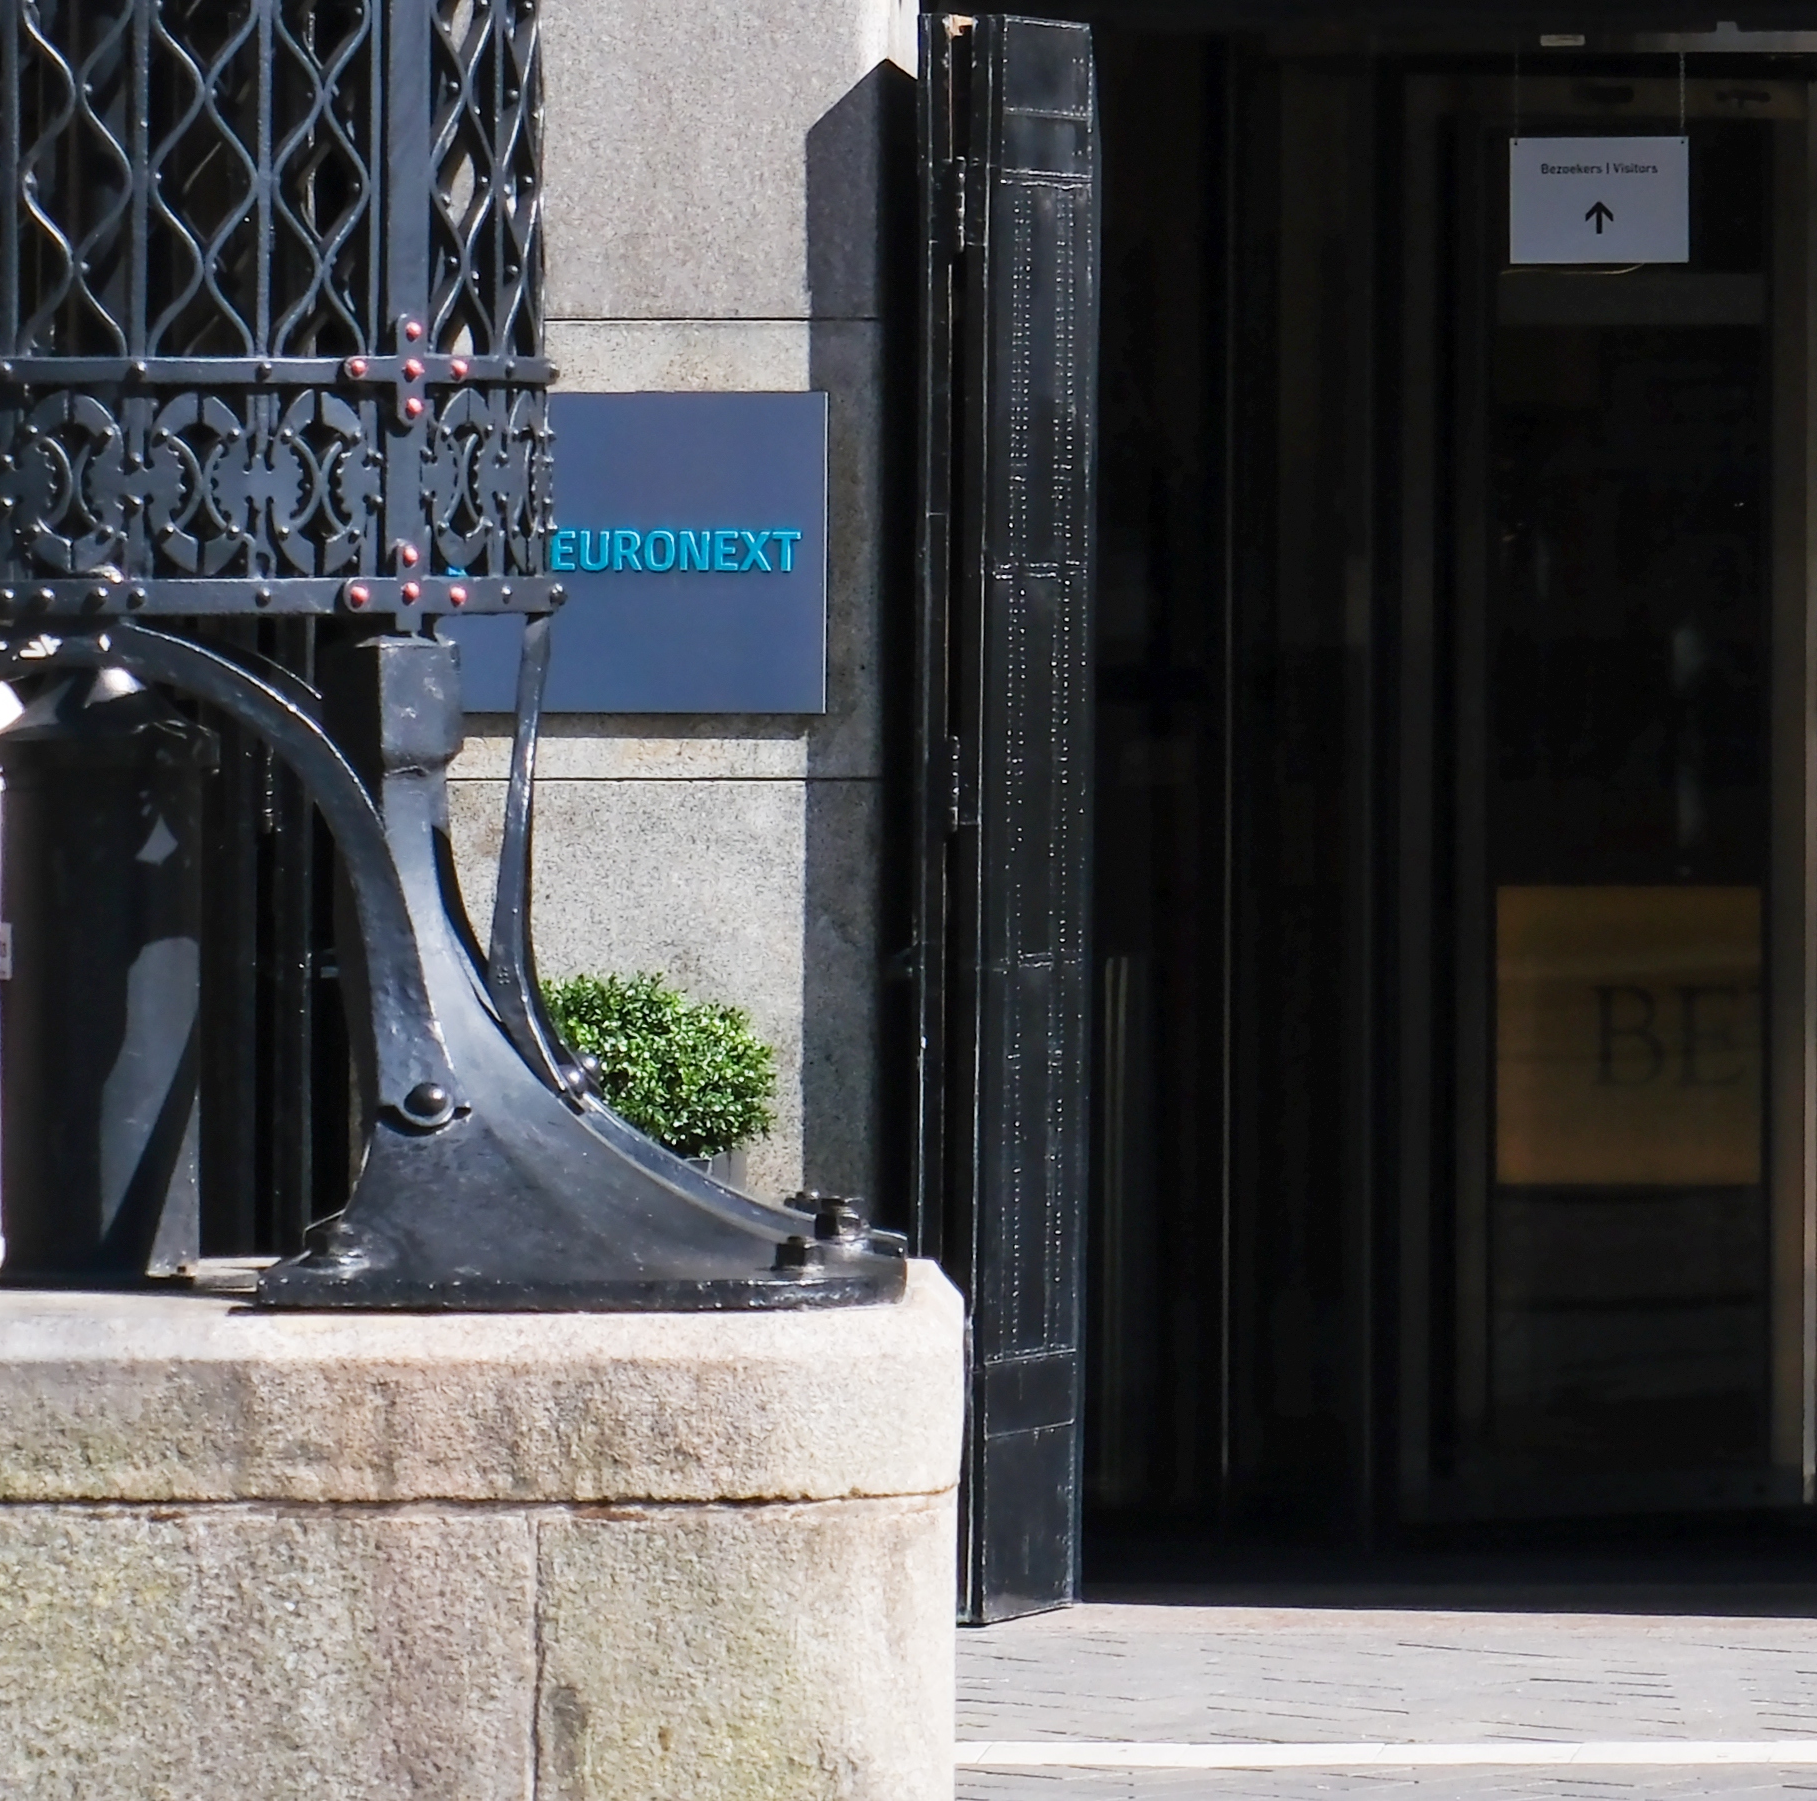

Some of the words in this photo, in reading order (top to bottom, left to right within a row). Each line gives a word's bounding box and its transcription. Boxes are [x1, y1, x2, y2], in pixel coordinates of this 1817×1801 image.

[1540, 163, 1603, 175] Bezoekers
[1613, 162, 1659, 175] Visitors
[550, 527, 803, 574] EURONEXT
